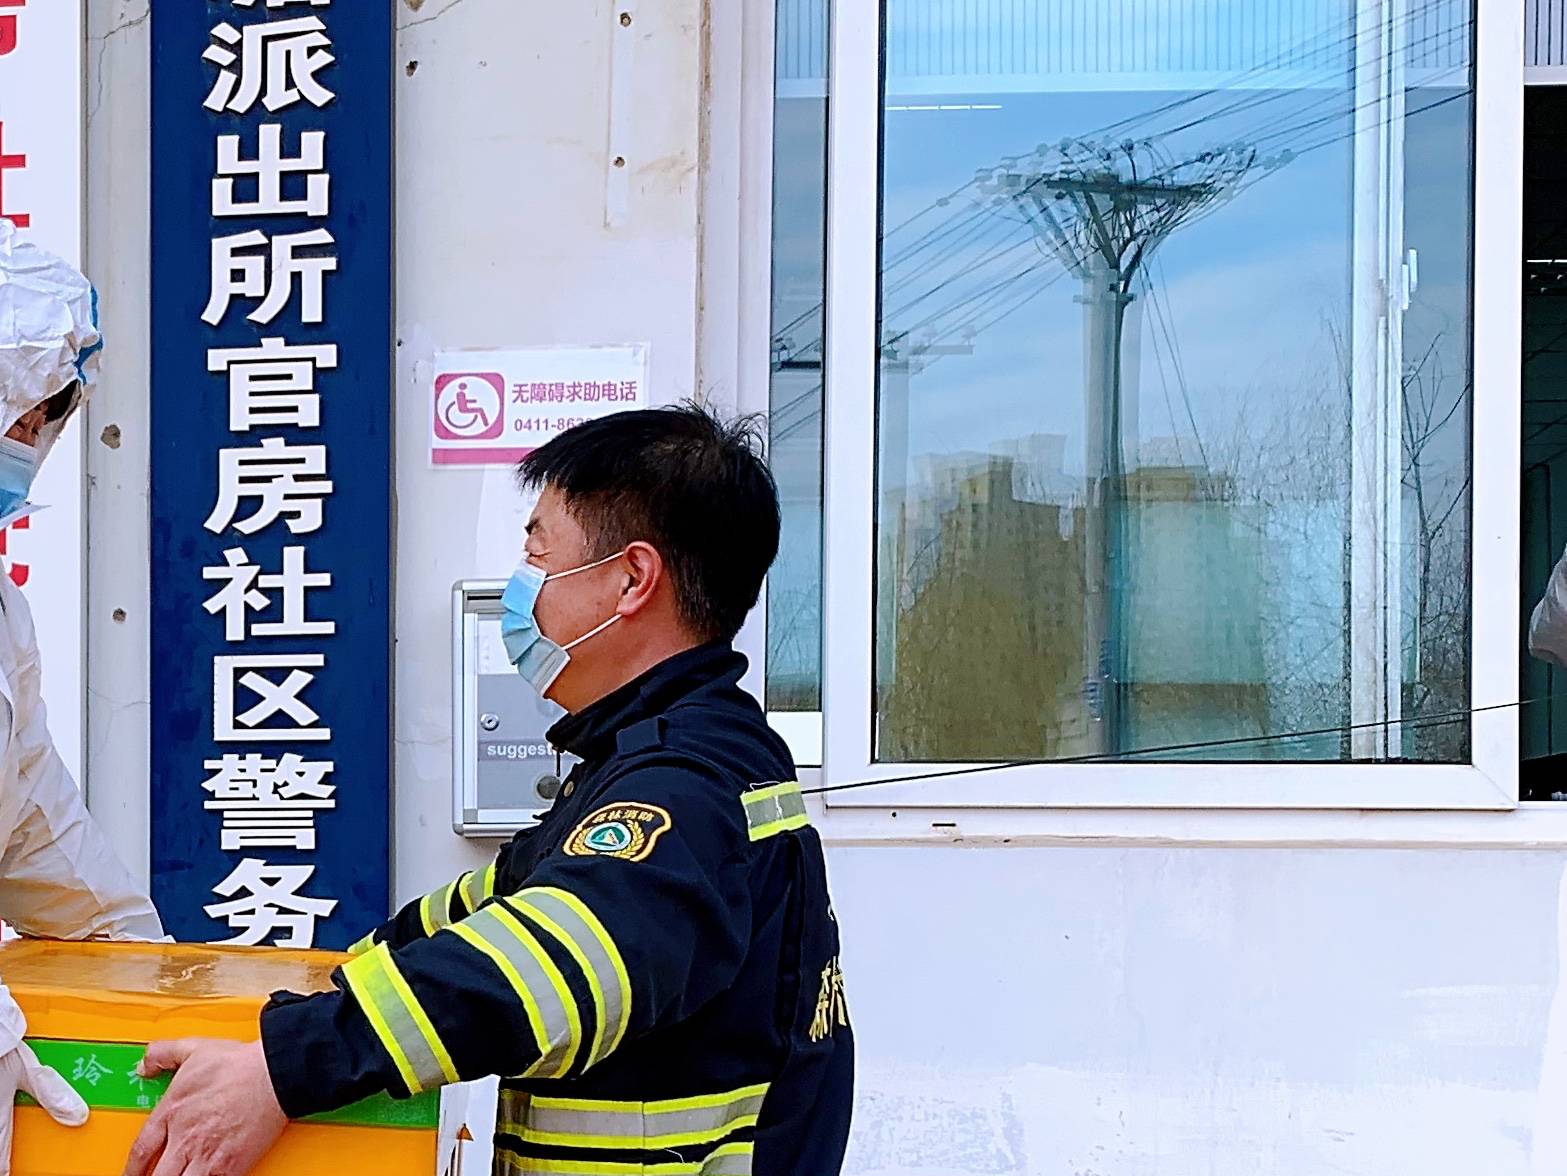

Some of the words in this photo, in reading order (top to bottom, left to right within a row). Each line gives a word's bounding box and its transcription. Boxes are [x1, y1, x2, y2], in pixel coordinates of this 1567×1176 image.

[512, 381, 638, 403] 无障碍求助电话
[514, 418, 592, 432] 0411-86
[202, 0, 338, 945] 派出所官房社区警务
[487, 743, 570, 760] suggest
